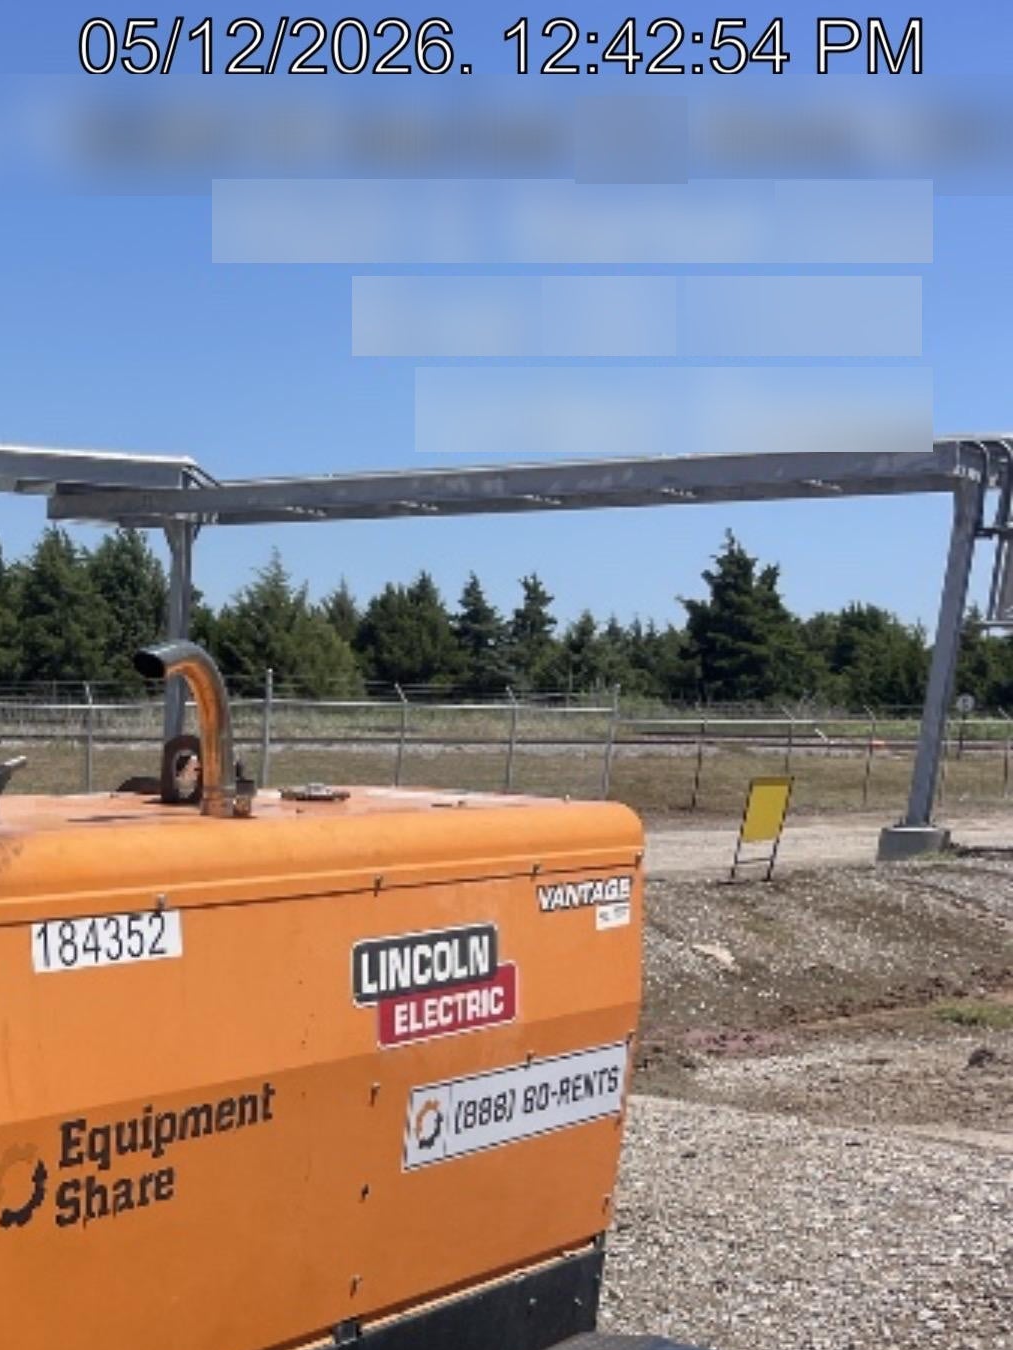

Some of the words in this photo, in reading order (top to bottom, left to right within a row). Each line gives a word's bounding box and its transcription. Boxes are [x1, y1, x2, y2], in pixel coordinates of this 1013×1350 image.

[537, 876, 632, 912] VANTAGE
[37, 912, 167, 967] 184352
[360, 934, 490, 994] LINCOLN
[393, 985, 505, 1036] ELECTRIC
[58, 1082, 276, 1170] Equipment
[454, 1087, 517, 1135] (888)
[55, 1166, 175, 1227] Share
